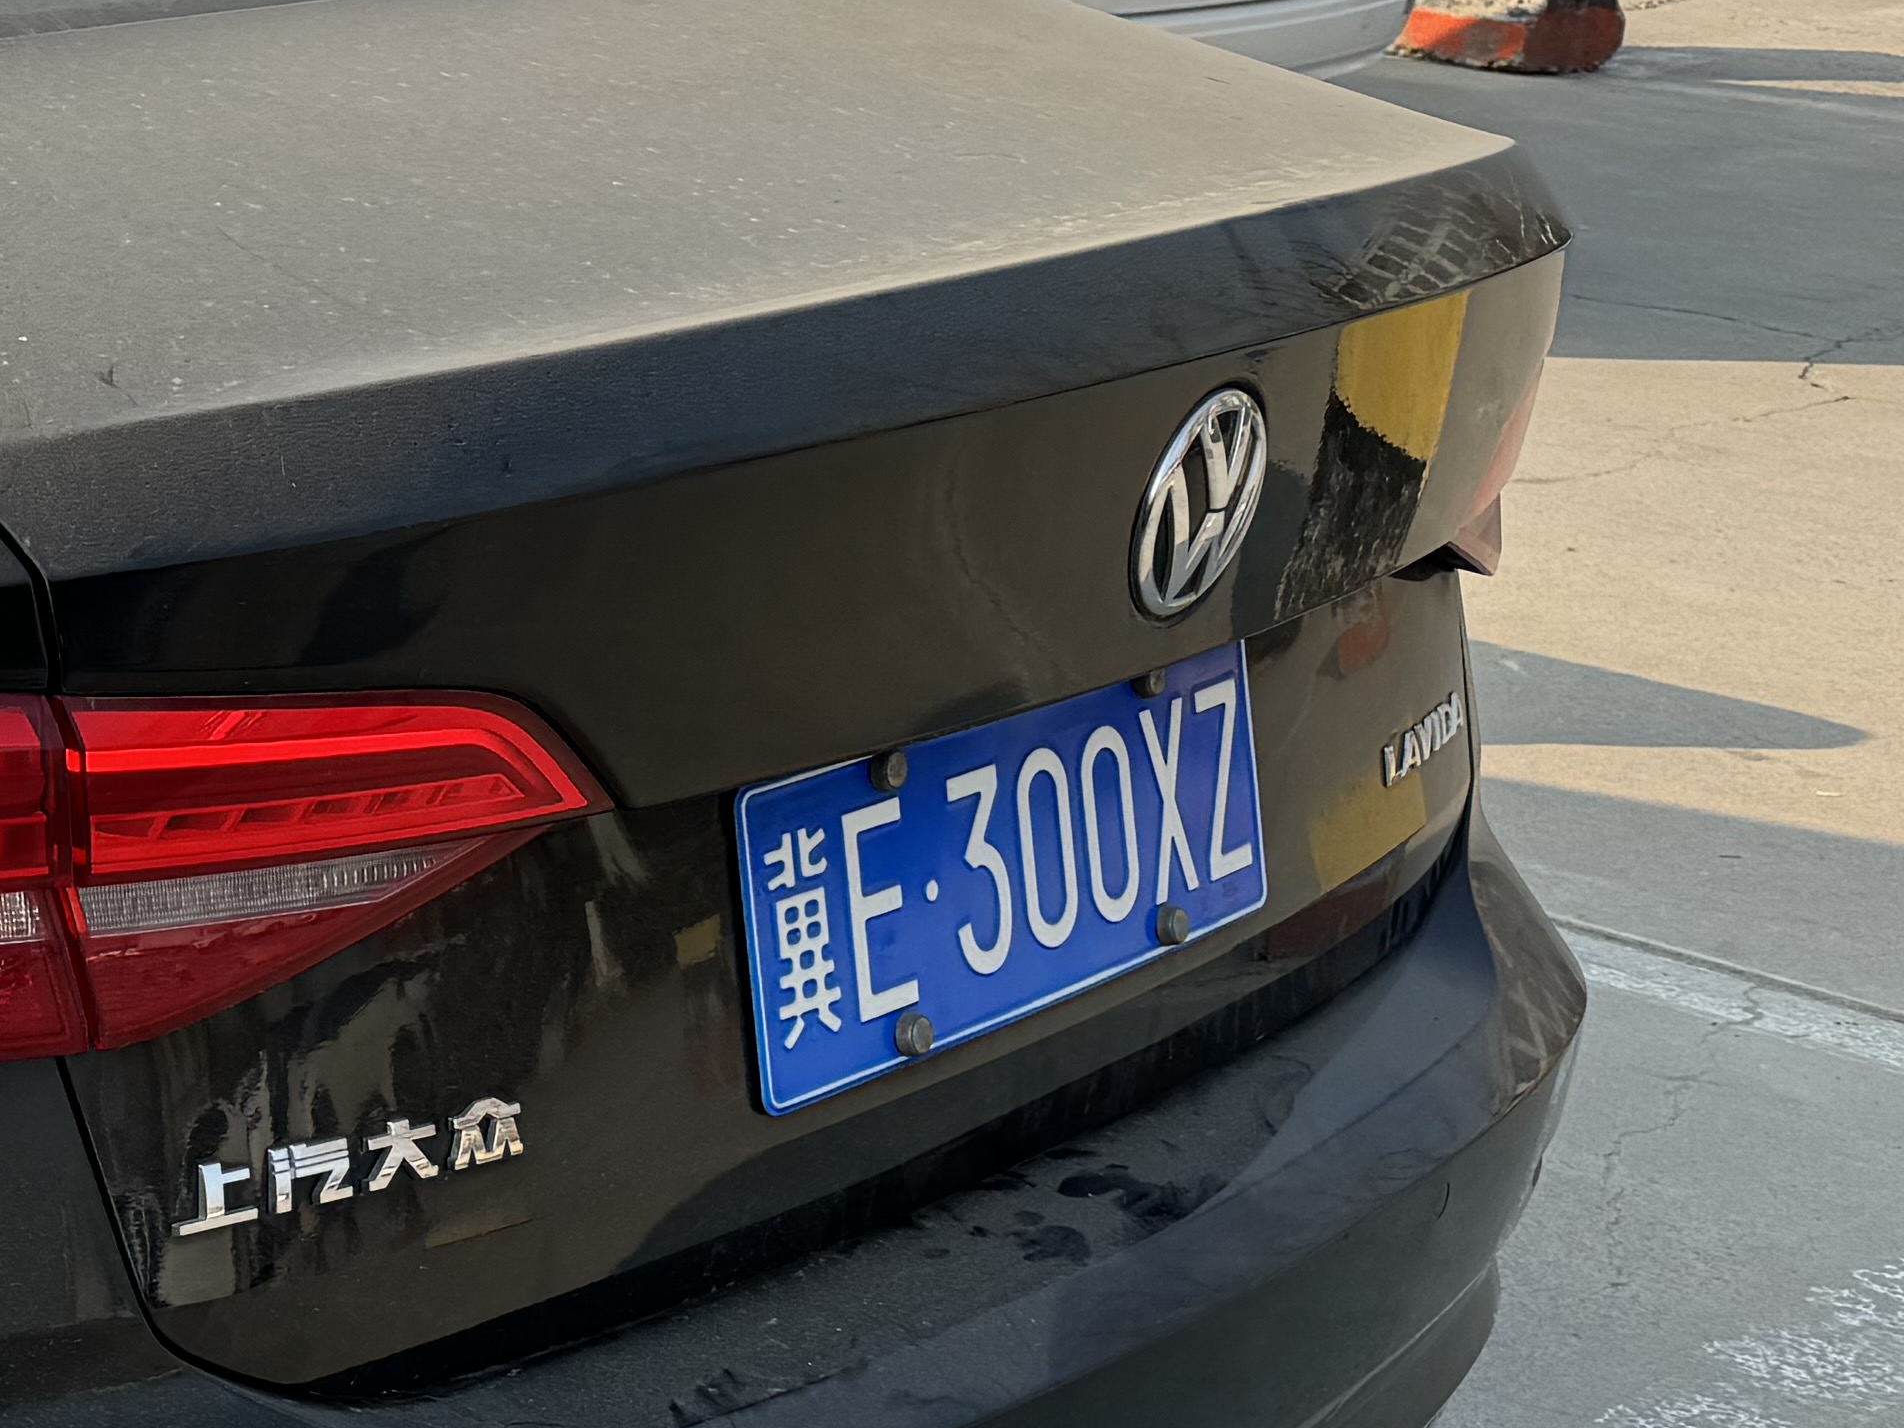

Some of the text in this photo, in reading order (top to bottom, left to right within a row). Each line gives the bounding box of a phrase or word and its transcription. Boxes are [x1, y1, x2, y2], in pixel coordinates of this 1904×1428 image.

[1382, 691, 1463, 787] LAVIDA
[172, 1096, 524, 1236] 上汽大众
